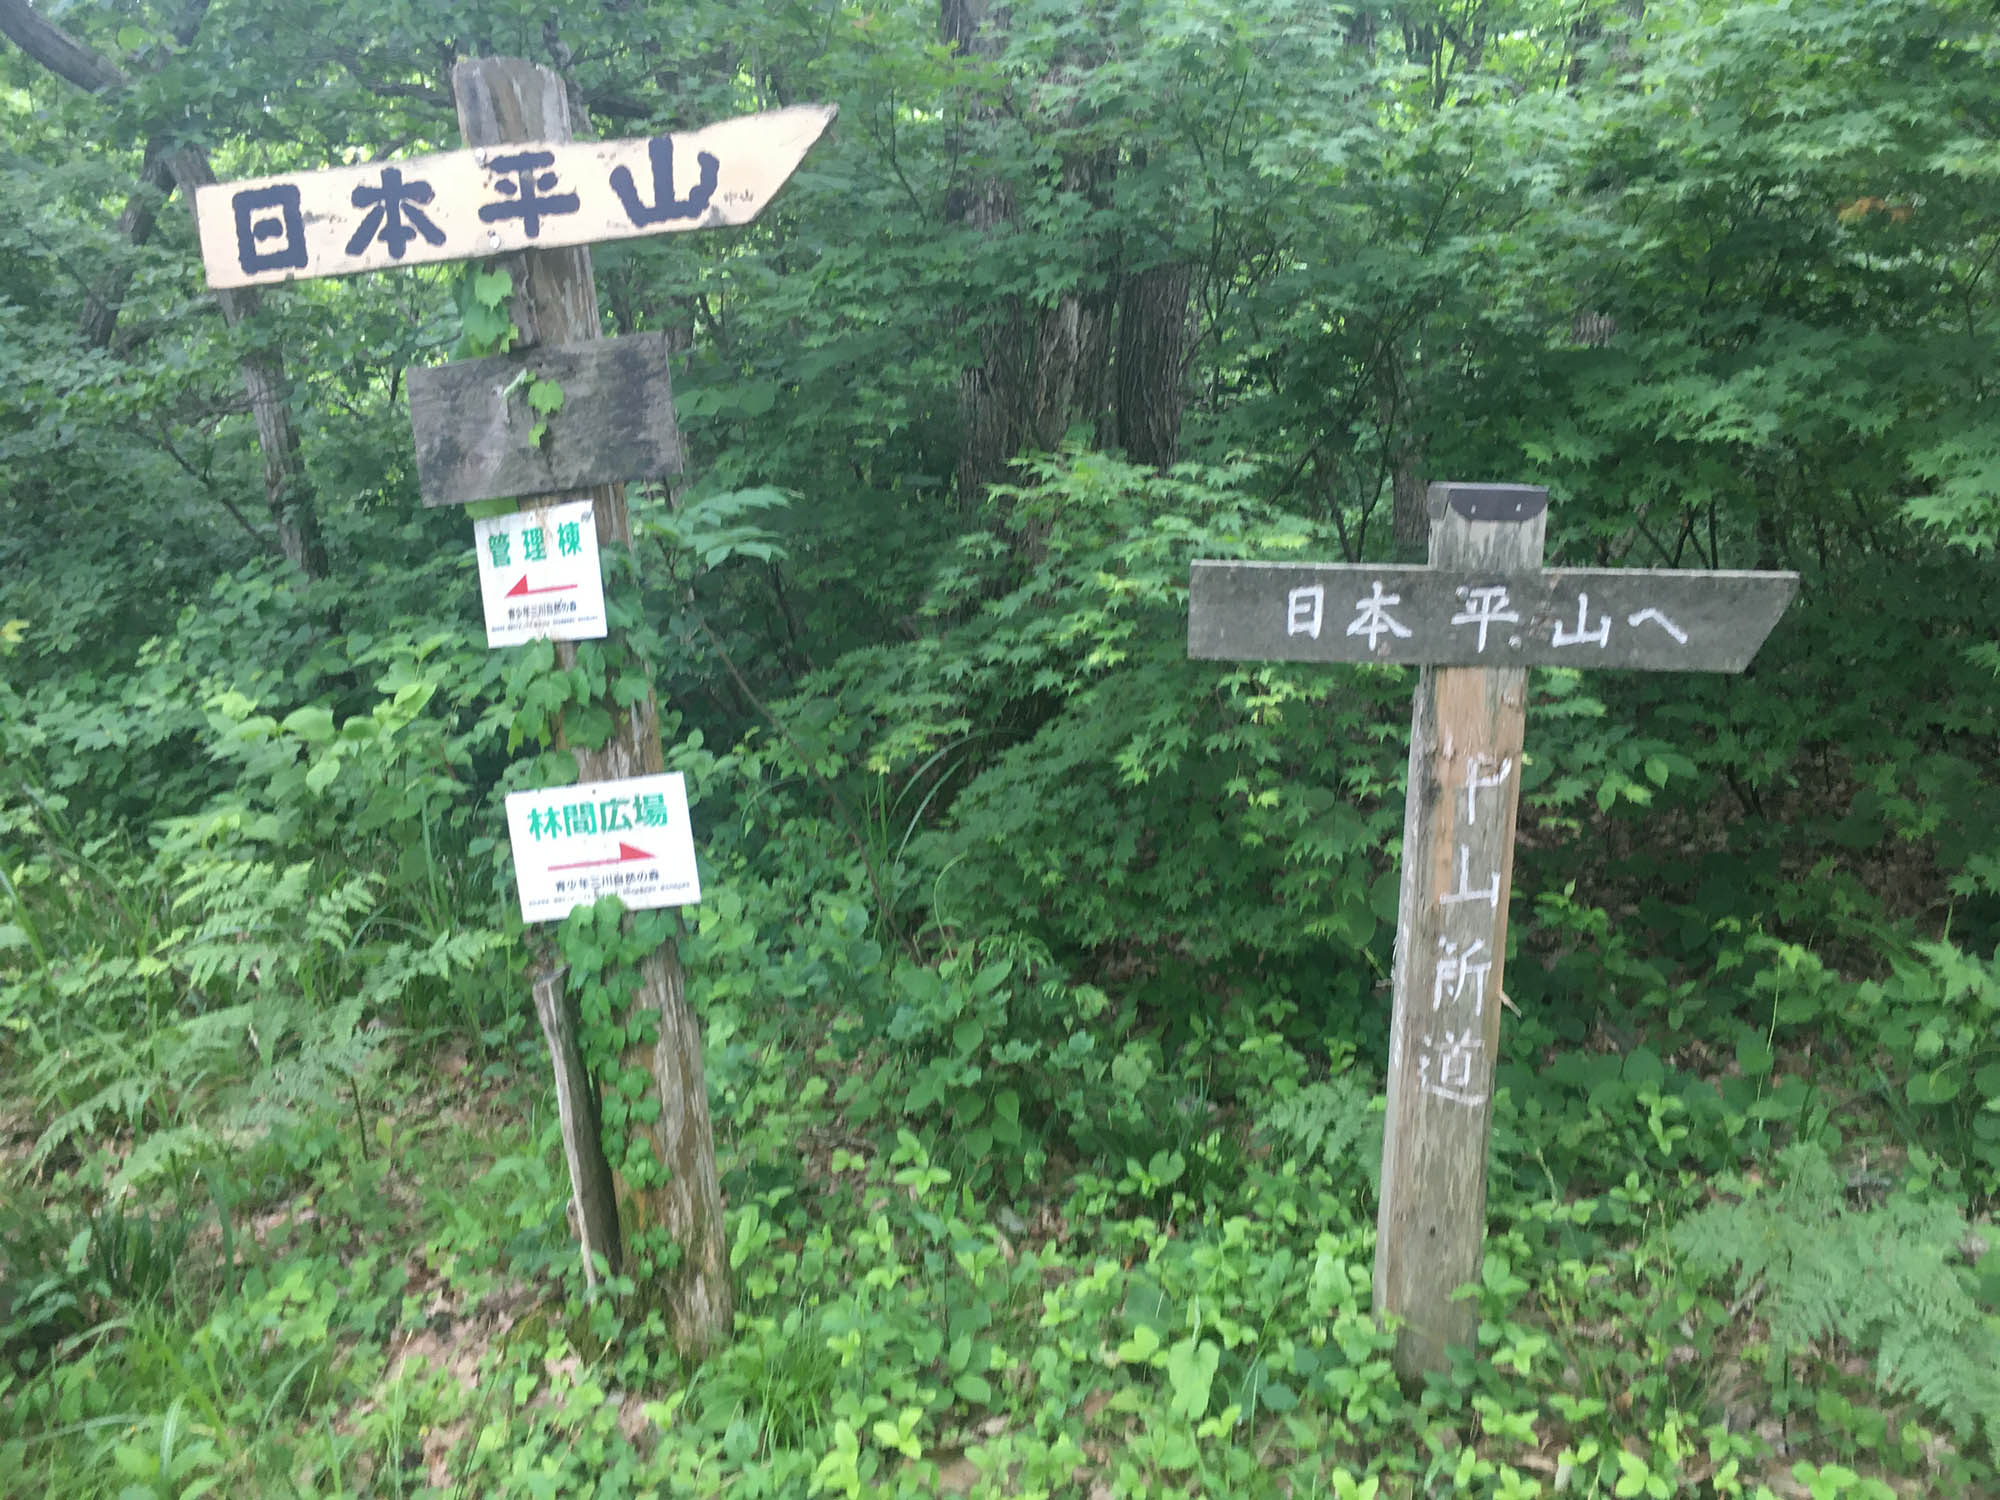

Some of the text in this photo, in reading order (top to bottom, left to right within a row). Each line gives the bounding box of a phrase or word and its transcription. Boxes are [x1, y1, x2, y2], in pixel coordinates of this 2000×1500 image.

[231, 135, 720, 275] 日本平山
[488, 520, 583, 568] 管理棟
[1286, 580, 1690, 654] 日本平山へ
[527, 792, 669, 842] 林間広場
